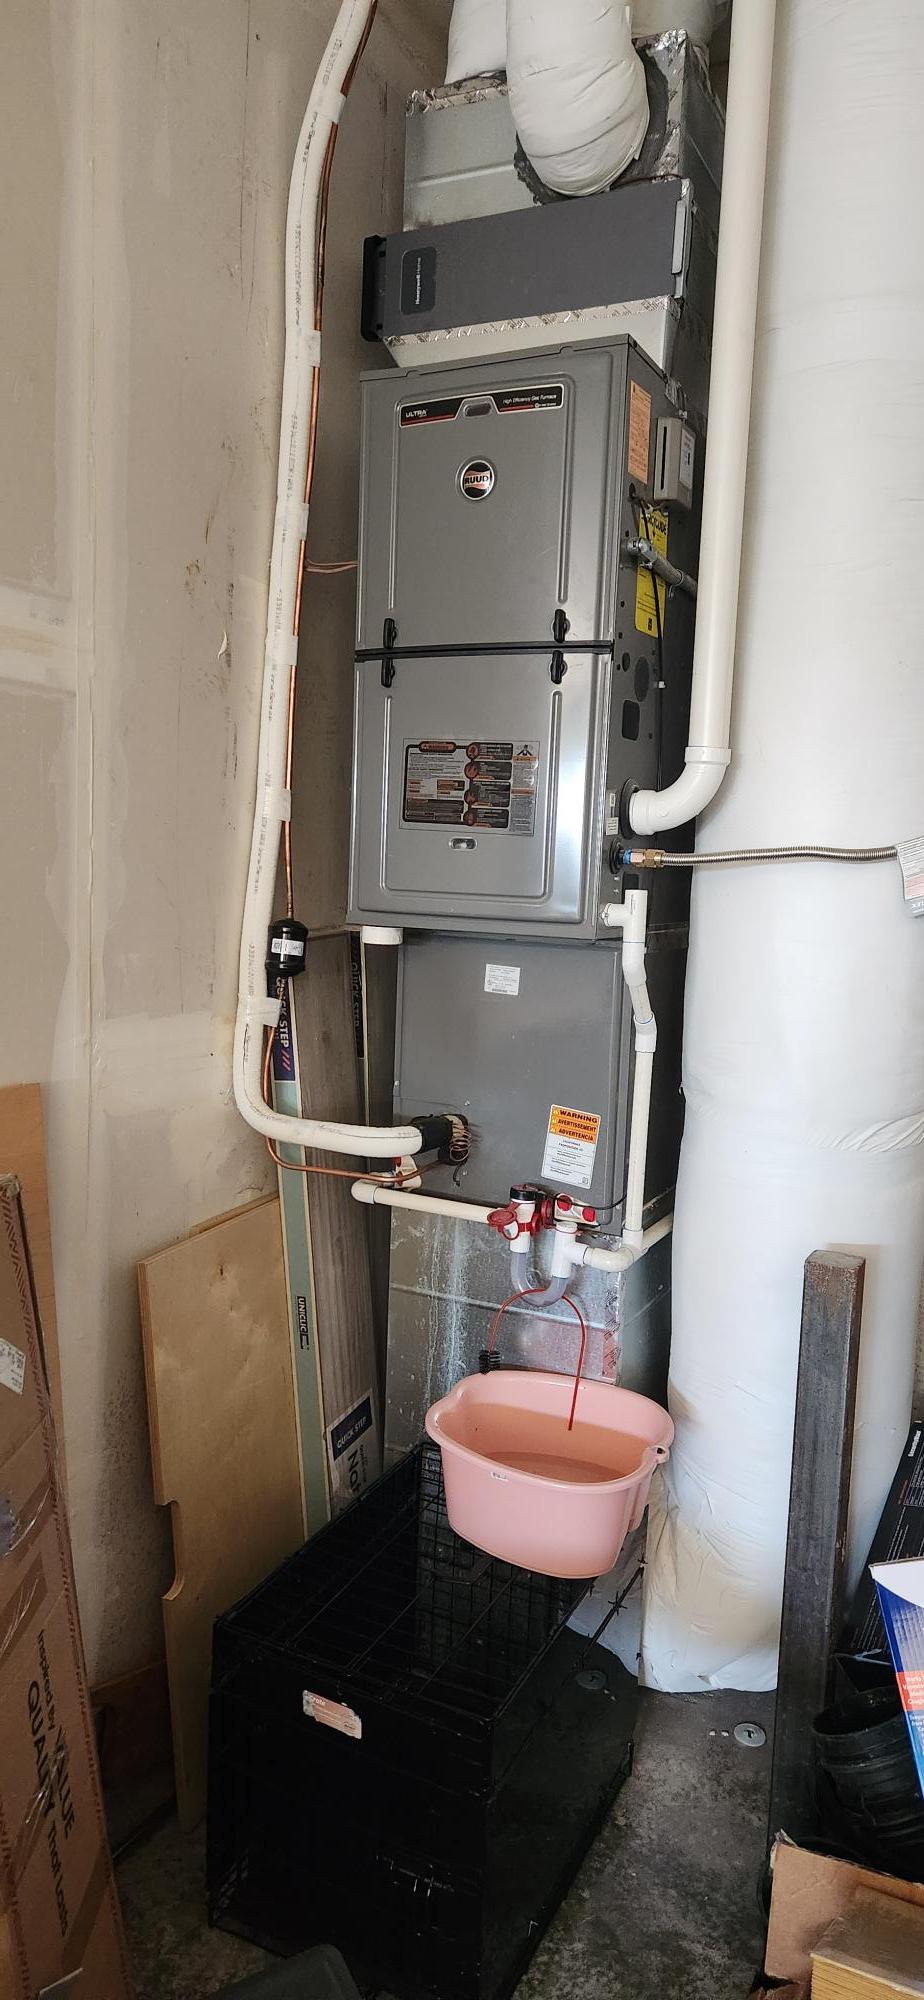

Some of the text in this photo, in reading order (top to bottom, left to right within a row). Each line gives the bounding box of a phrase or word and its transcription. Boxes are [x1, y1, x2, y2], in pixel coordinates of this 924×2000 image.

[405, 409, 428, 418] ULTRA
[464, 475, 489, 485] RUUD
[280, 1019, 290, 1048] STEP
[560, 1110, 598, 1124] WARNING
[558, 1118, 597, 1132] AVERTISSEMENT
[558, 1128, 594, 1141] ADVERTENCIA
[298, 1297, 308, 1332] UNICLIC
[56, 1725, 75, 1840] VALUE
